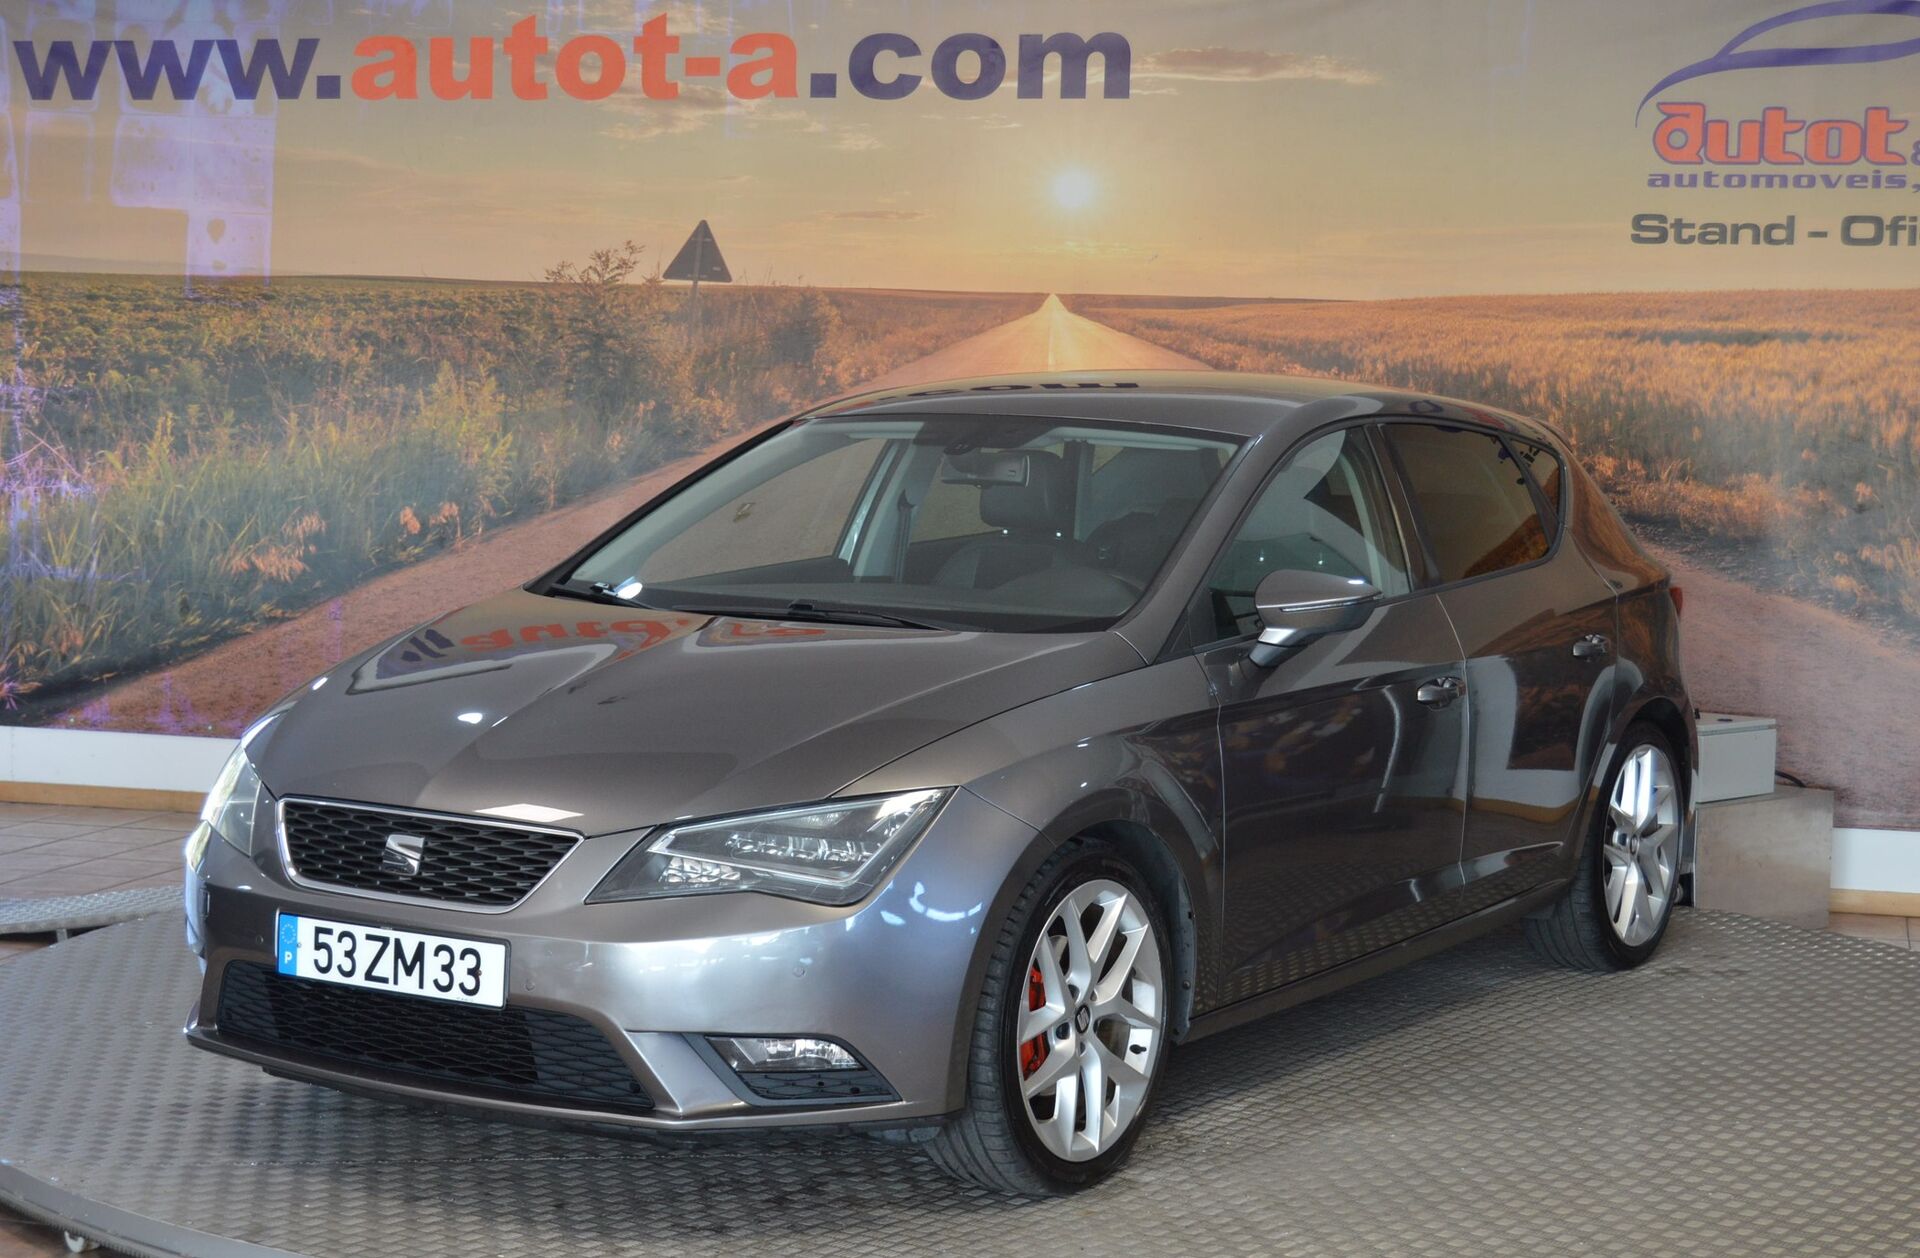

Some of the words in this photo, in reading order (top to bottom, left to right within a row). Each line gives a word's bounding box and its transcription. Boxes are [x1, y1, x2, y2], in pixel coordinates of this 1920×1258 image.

[13, 12, 1132, 101] www.autot-a.com
[1630, 213, 1795, 245] Stand
[1840, 214, 1920, 246] Ofi
